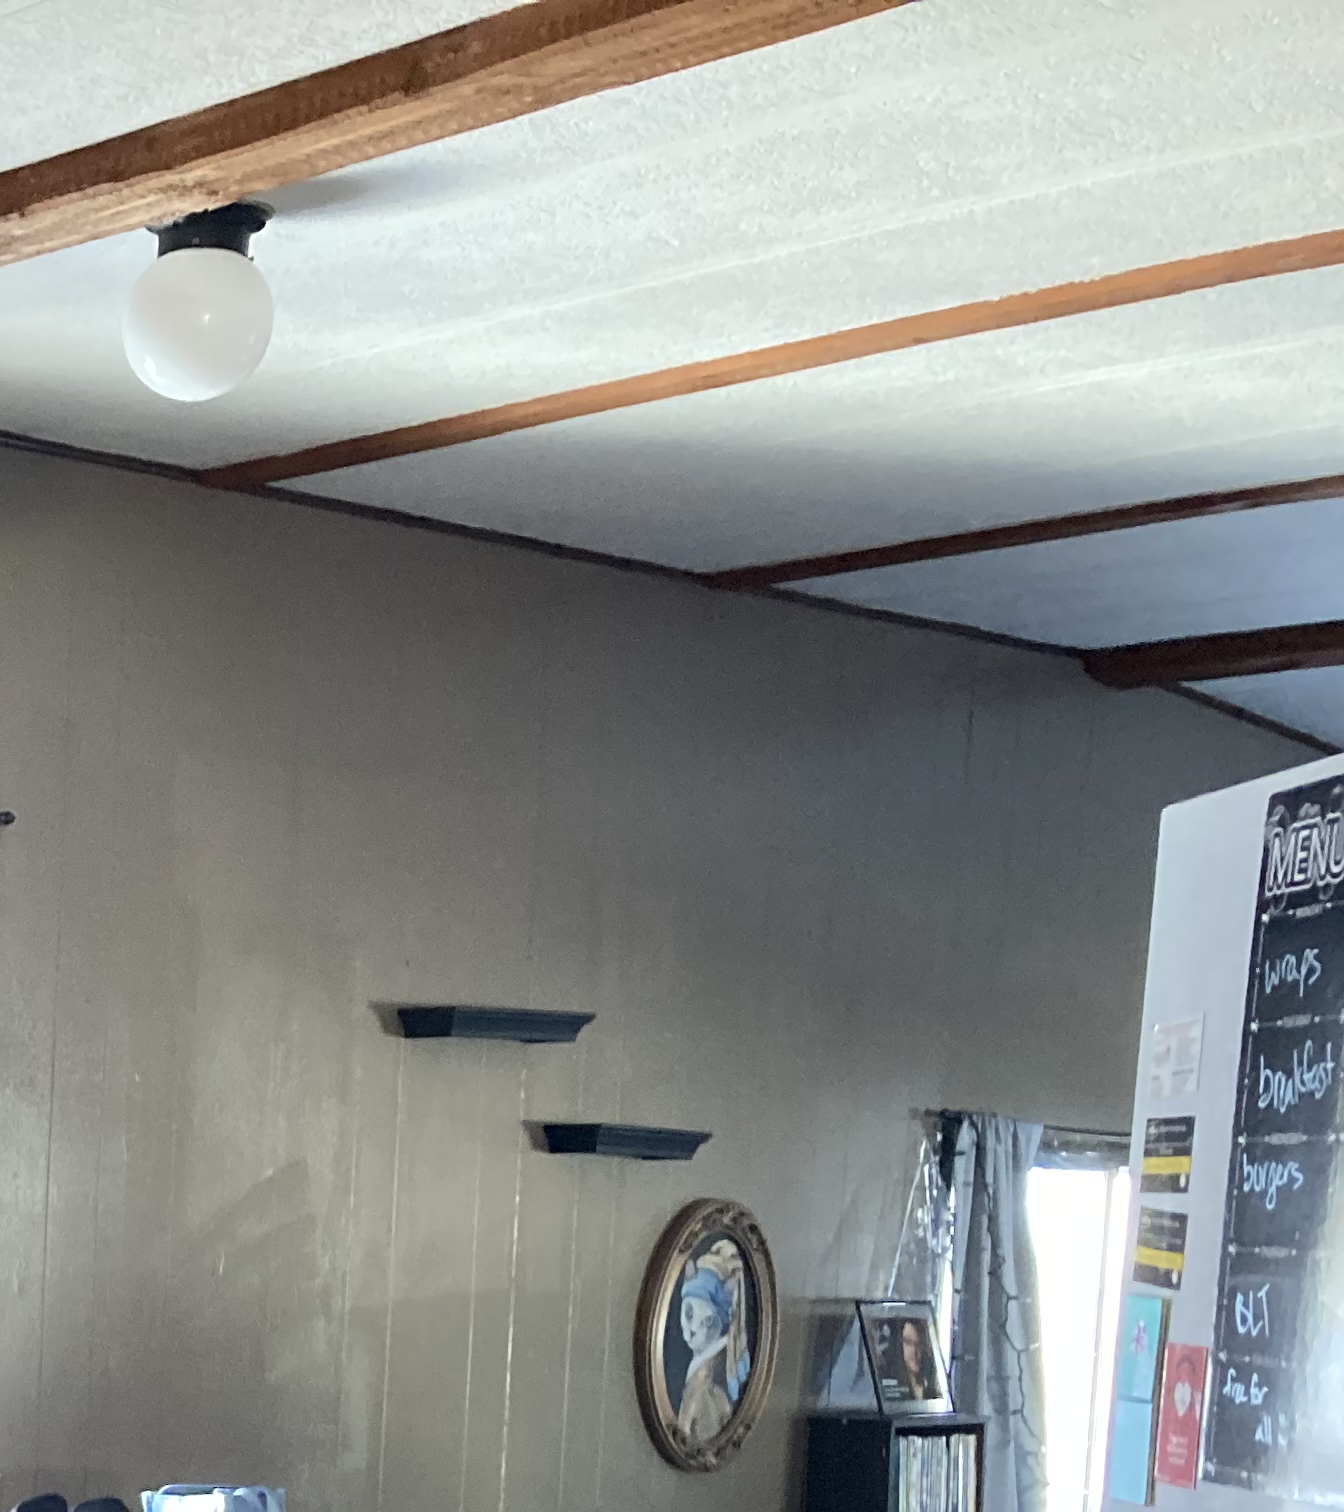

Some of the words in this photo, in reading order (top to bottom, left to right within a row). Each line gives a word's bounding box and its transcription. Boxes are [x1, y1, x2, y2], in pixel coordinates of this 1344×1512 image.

[1264, 812, 1344, 896] MENU
[1264, 948, 1322, 998] wraps
[1242, 1152, 1305, 1210] burgers
[1234, 1284, 1270, 1339] BLT
